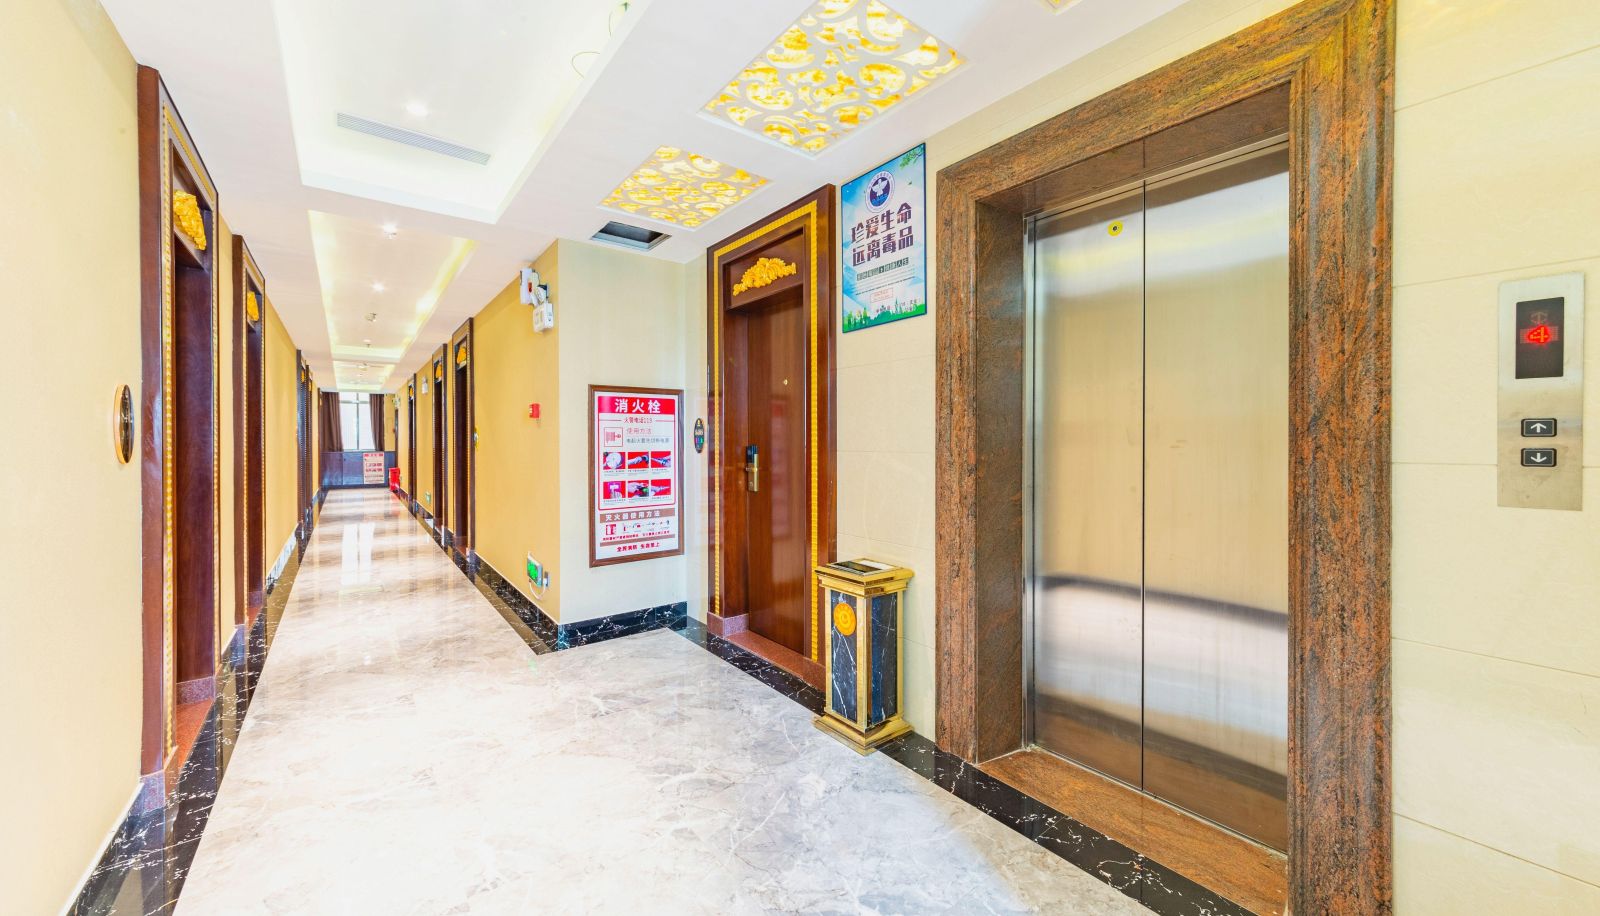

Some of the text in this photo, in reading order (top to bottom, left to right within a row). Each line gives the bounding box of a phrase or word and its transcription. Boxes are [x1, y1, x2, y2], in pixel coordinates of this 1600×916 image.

[851, 202, 912, 244] 珍爱生命
[852, 225, 914, 267] 远离毒品
[1529, 326, 1549, 343] 4
[614, 398, 661, 414] 消火栓
[626, 427, 652, 436] 使用方法
[605, 510, 661, 522] 灭火器使用方法
